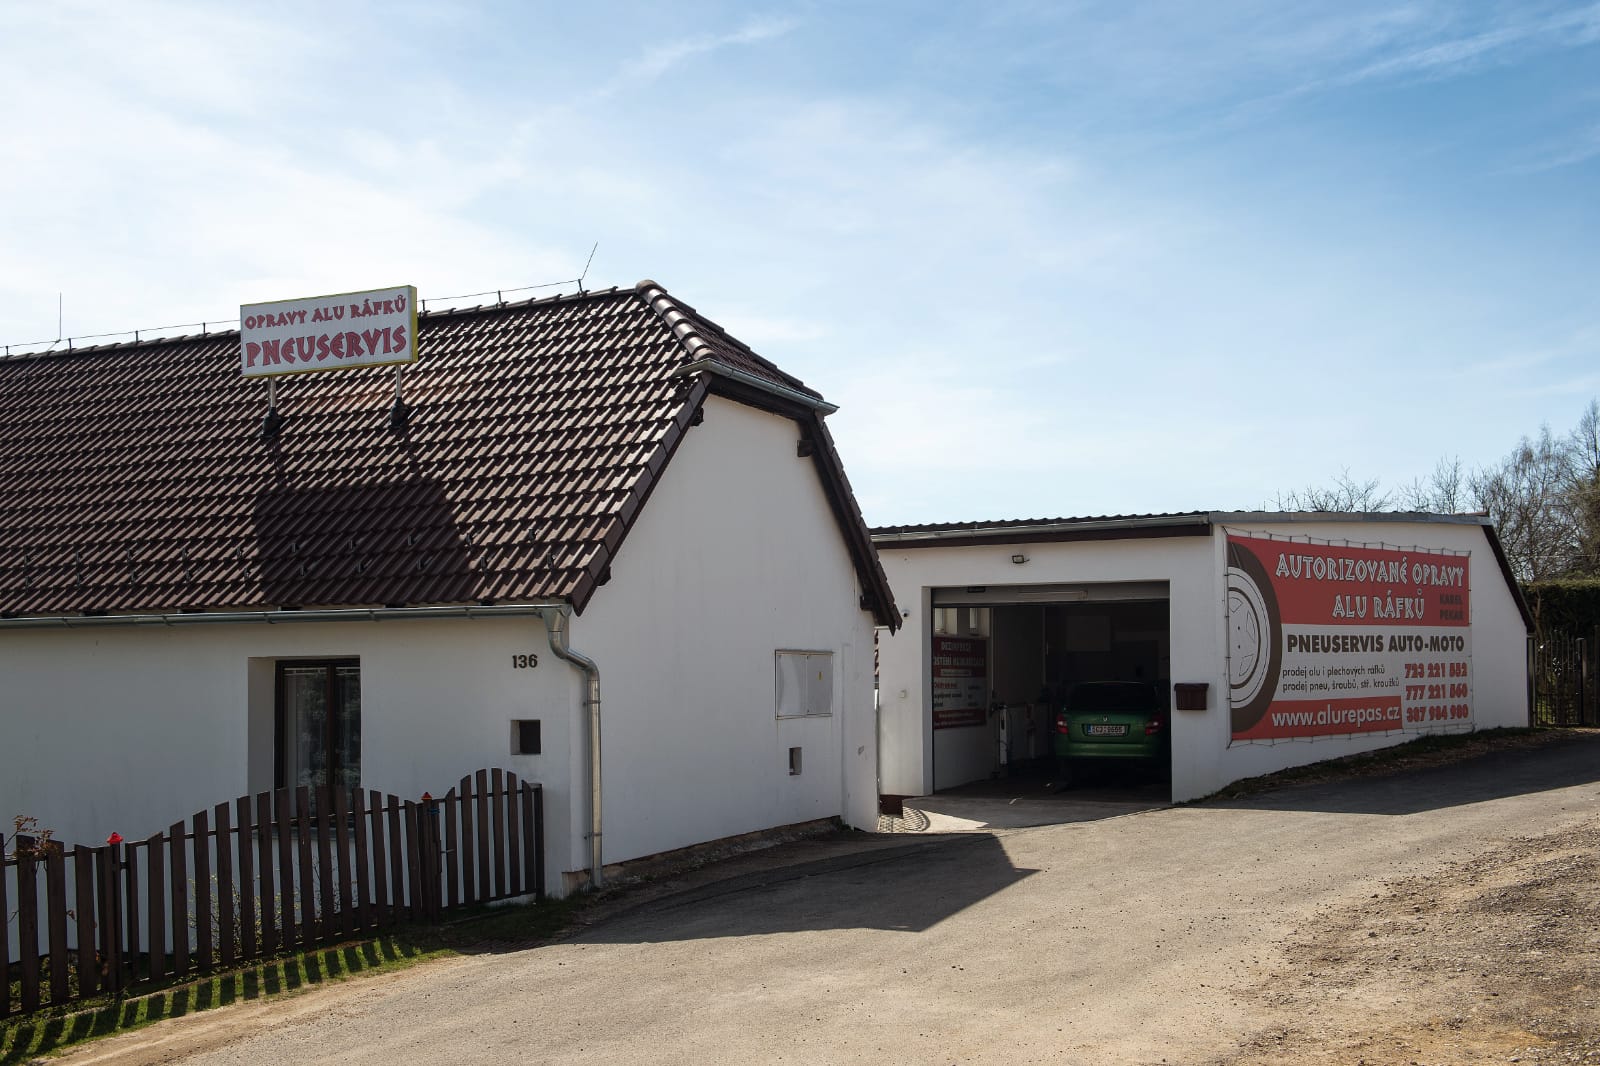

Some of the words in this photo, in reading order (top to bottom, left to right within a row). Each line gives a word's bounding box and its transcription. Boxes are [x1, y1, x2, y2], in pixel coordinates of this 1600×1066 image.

[245, 310, 308, 330] OPRAVY
[311, 305, 345, 323] ALU
[351, 294, 407, 319] RÁFKŮ
[245, 325, 407, 368] PNEUSERVIS
[1275, 552, 1408, 585] AUTORIZOVANÉ
[1412, 562, 1464, 587] OPRAVY
[1332, 594, 1367, 619] ALU
[1373, 588, 1425, 620] RÁFKŮ
[1287, 634, 1384, 653] PNEUSERVIS
[1388, 635, 1465, 652] AUTO-MOTO
[512, 654, 538, 669] 136
[1405, 663, 1425, 679] 723
[1427, 662, 1446, 678] 221
[1282, 666, 1306, 679] prodej
[1309, 667, 1320, 676] alu
[1327, 666, 1365, 678] plechových
[1282, 680, 1307, 693] prodej
[1309, 682, 1330, 693] pneu,
[1373, 677, 1400, 688] kroužků
[1406, 685, 1426, 700] 777
[1428, 684, 1446, 699] 221
[1272, 703, 1401, 728] www.alurepas.cz
